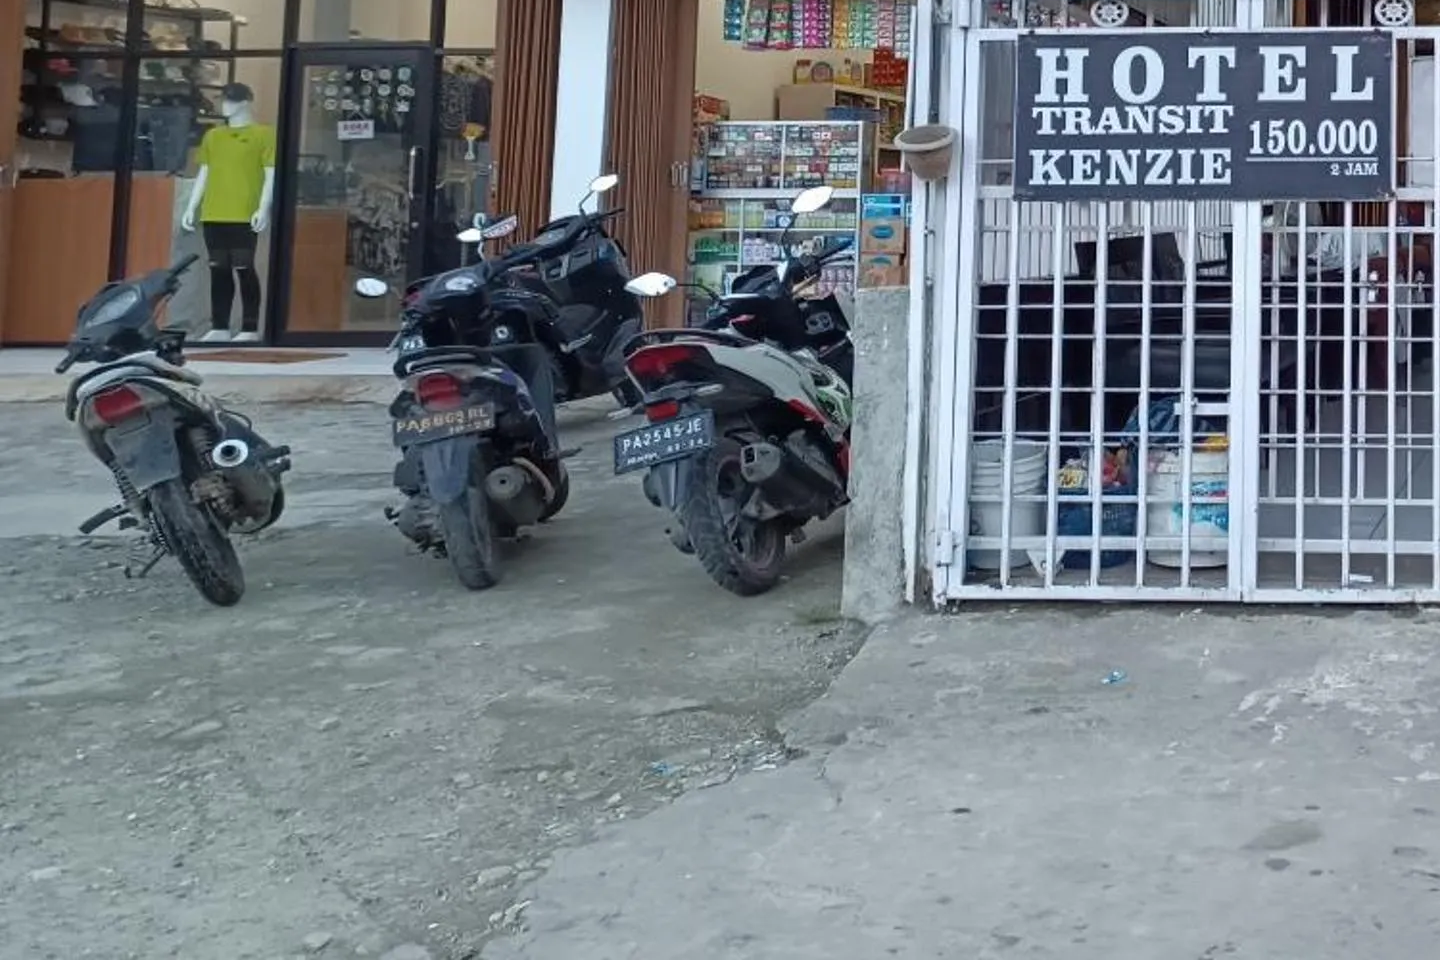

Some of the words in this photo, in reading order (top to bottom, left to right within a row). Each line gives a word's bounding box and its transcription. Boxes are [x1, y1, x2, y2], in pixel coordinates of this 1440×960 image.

[1034, 46, 1374, 104] HOTEL
[1032, 105, 1234, 136] TRANSIT
[1249, 119, 1378, 155] 150.000
[1029, 148, 1232, 186] KENZIE
[1330, 163, 1340, 177] 2
[1344, 163, 1379, 177] JAM
